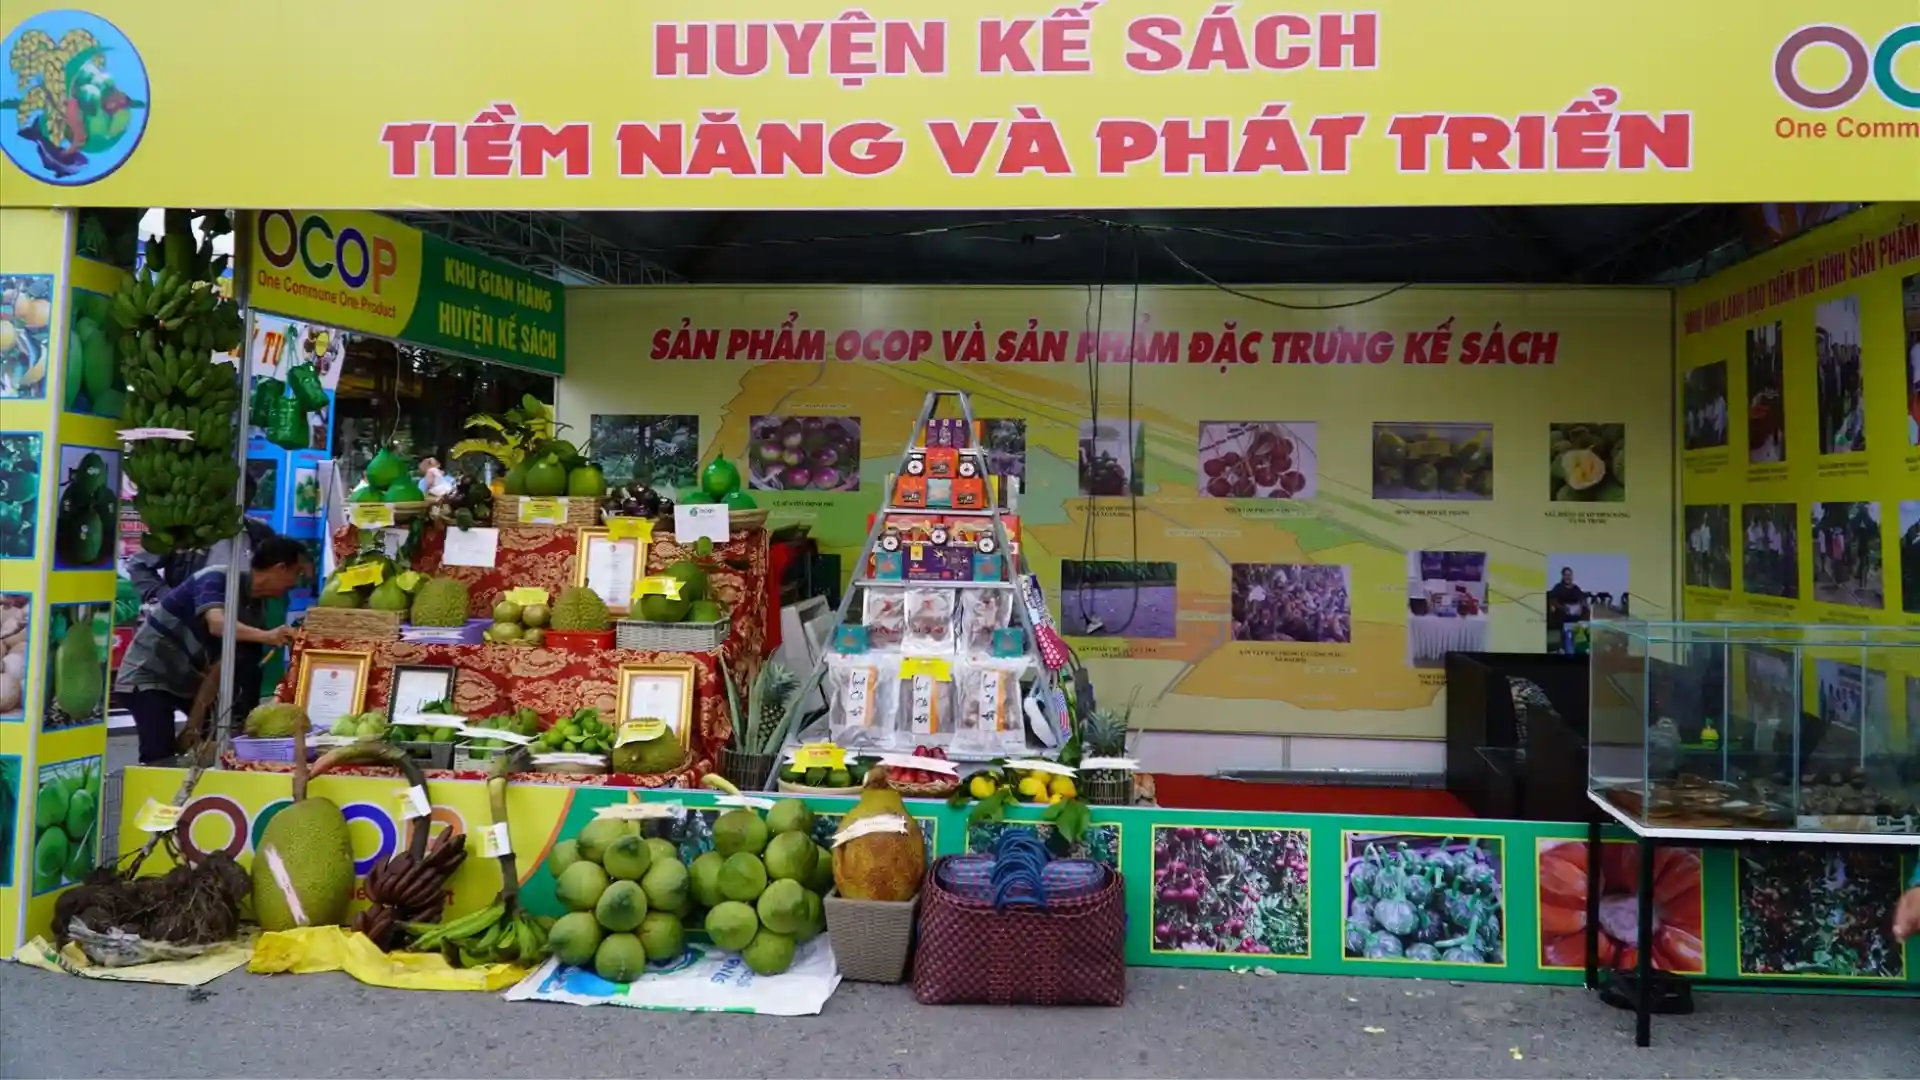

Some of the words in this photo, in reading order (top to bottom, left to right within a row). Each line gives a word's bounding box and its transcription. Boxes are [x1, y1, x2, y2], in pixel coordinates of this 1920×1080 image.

[655, 10, 946, 86] HUYỆN
[980, 1, 1100, 73] KẾ
[1125, 4, 1377, 72] SÁCH
[381, 102, 592, 177] TIỀM
[617, 110, 904, 176] NĂNG
[926, 106, 1073, 175] VÀ
[1096, 104, 1367, 174] PHÁT
[1387, 86, 1692, 170] TRIỂN
[1775, 117, 1826, 138] One
[257, 208, 397, 296] OCOP
[444, 256, 476, 290] KHU
[479, 269, 514, 302] GIAN
[1850, 233, 1876, 278] SẢN
[258, 270, 280, 289] One
[284, 277, 337, 304] Commune
[340, 291, 359, 309] One
[360, 296, 396, 319] Product
[439, 301, 494, 350] HUYỆN
[498, 312, 517, 352] KẾ
[521, 321, 556, 360] SÁCH
[650, 317, 721, 361] SẢN
[725, 311, 827, 361] PHẨM
[834, 328, 933, 362] OCOP
[942, 320, 987, 362] VÀ
[994, 319, 1070, 363] SẢN
[1188, 320, 1264, 374] ĐẶC
[1271, 324, 1396, 364] TRƯNG
[1403, 316, 1456, 364] KẾ
[1458, 321, 1560, 364] SÁCH
